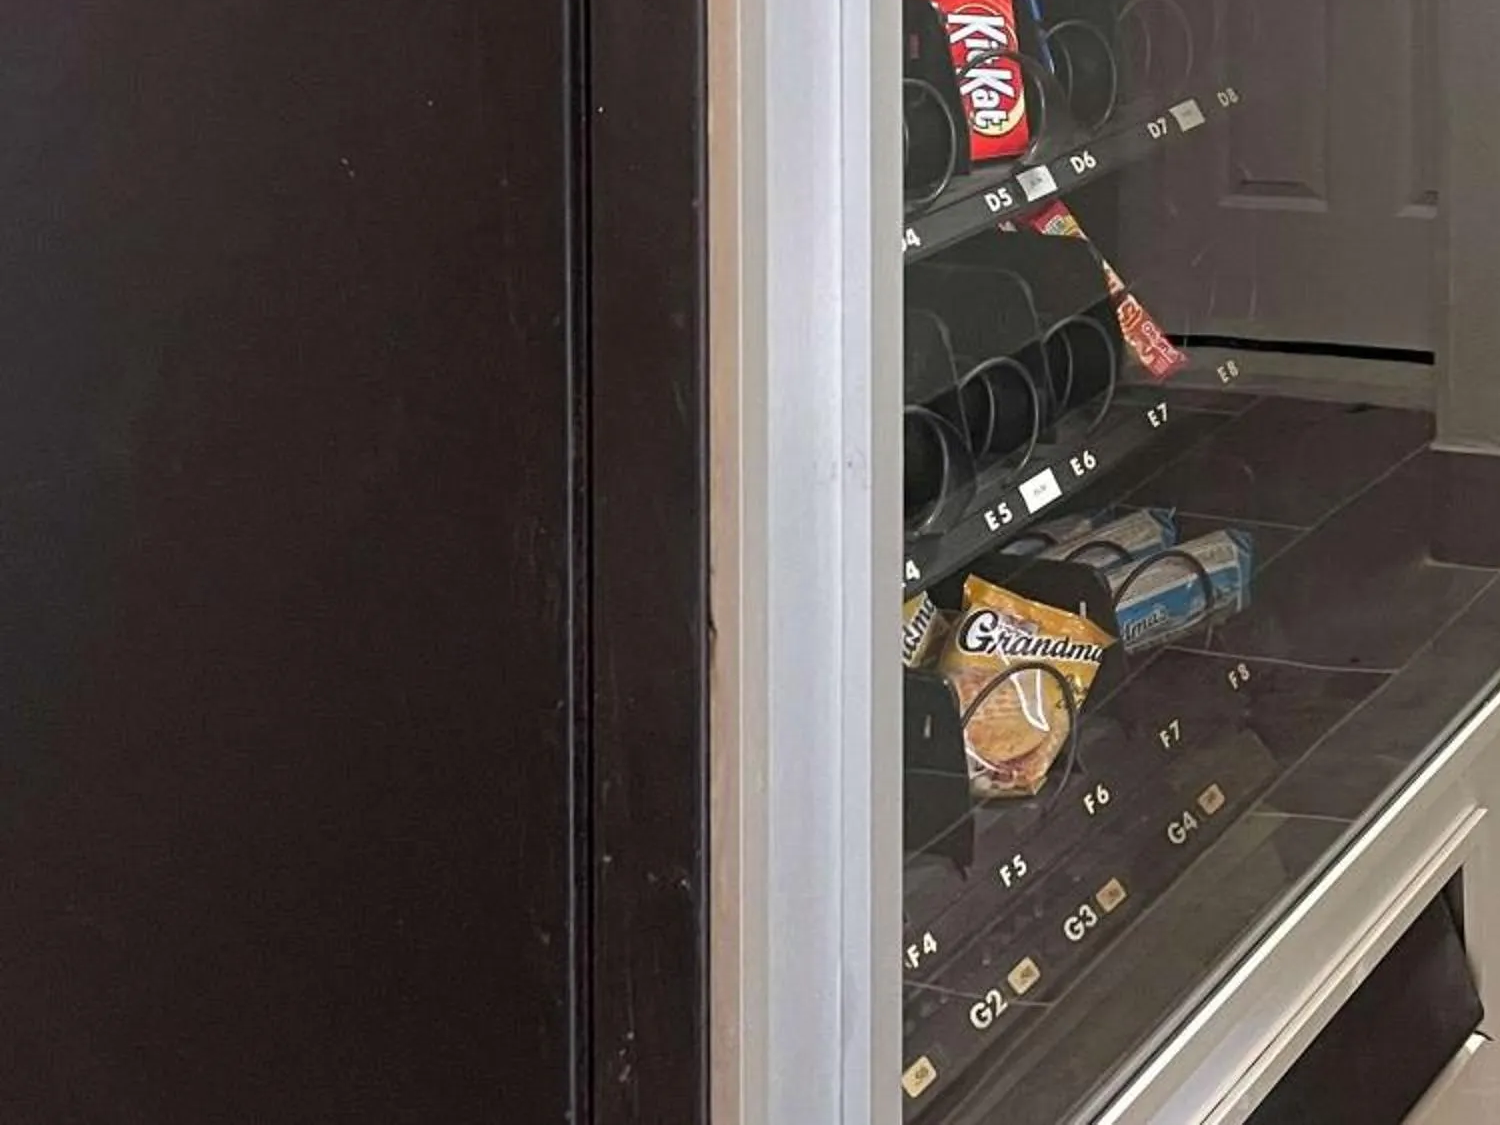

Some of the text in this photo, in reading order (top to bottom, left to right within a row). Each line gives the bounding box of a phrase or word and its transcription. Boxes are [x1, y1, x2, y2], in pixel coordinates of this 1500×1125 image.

[1216, 87, 1239, 108] D8
[1147, 117, 1169, 139] D7
[1070, 151, 1097, 174] D6
[984, 188, 1014, 213] D5
[1217, 359, 1240, 384] E8
[1147, 402, 1169, 428] E7
[1069, 450, 1097, 477] E6
[983, 502, 1013, 533] E5
[1228, 663, 1251, 690] F8
[1159, 719, 1181, 748] F7
[1083, 783, 1110, 815] F6
[1168, 811, 1198, 844] G4
[1000, 854, 1028, 887] F5
[1064, 904, 1098, 941] G3
[907, 931, 937, 969] F4
[969, 989, 1008, 1029] G2
